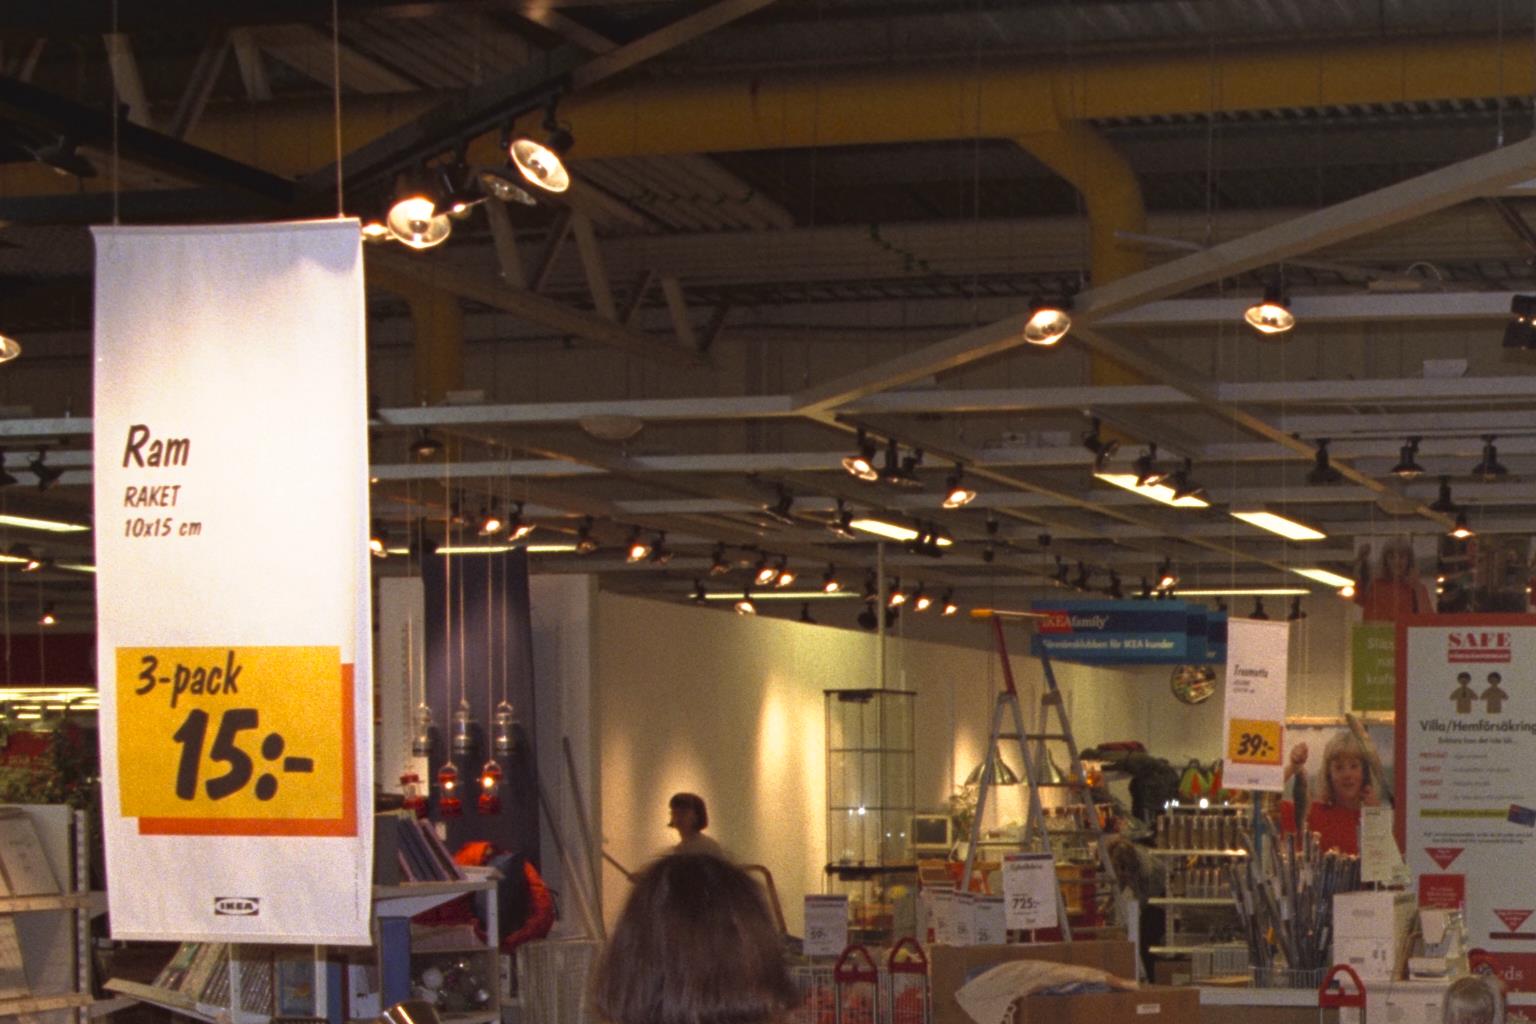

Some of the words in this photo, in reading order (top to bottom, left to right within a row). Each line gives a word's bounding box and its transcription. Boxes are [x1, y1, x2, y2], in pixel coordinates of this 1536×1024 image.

[122, 423, 191, 468] Ram
[124, 485, 181, 507] RAKET
[124, 518, 172, 538] 10x15
[178, 521, 202, 537] cm
[1448, 632, 1511, 647] SAFE
[134, 650, 243, 709] 3-pack
[171, 707, 314, 802] 15:-
